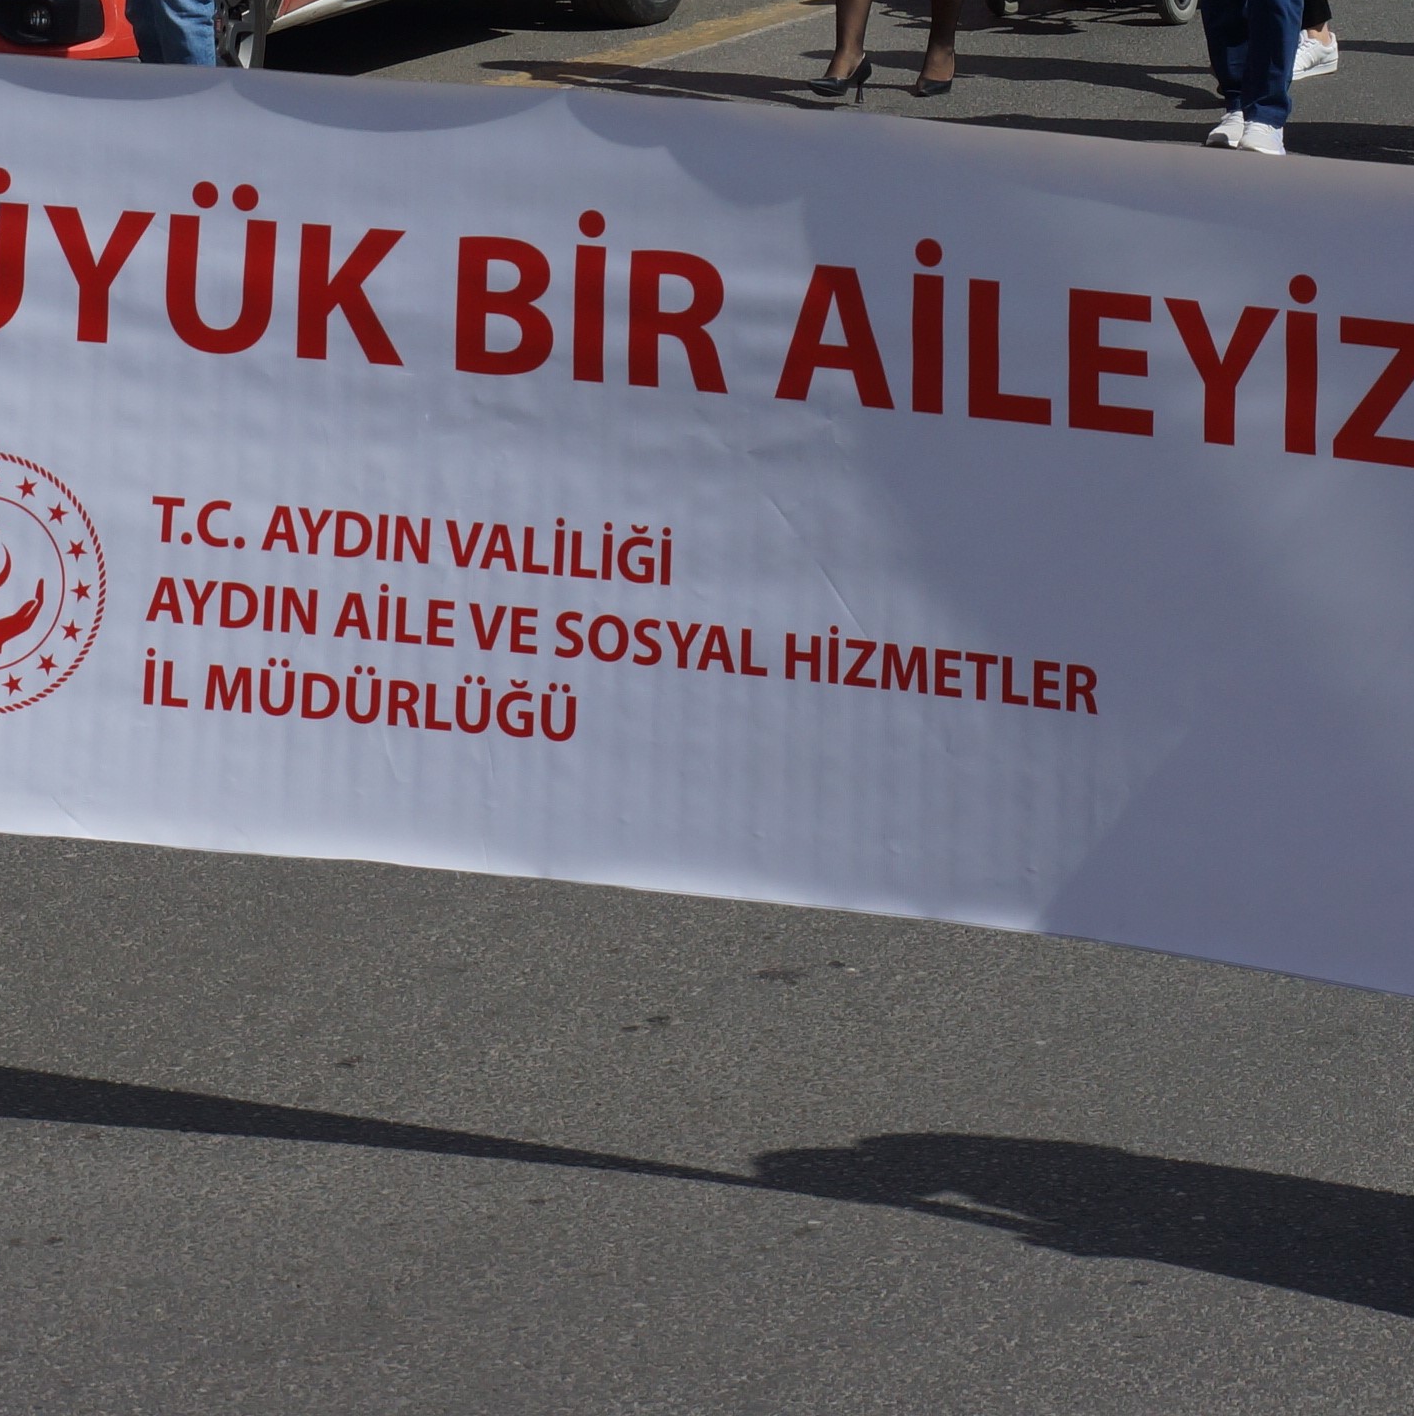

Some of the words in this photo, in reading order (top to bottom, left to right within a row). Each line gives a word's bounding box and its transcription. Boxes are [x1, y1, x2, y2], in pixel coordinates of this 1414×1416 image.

[454, 209, 728, 395] BİR
[152, 495, 246, 550] T.C.
[261, 506, 432, 565] AYDIN
[446, 517, 673, 586] VALİLİĞİ
[142, 647, 189, 709] İL
[204, 657, 577, 742] MÜDÜRLÜĞÜ
[145, 576, 318, 636] AYDIN
[333, 583, 456, 648] AİLE
[469, 602, 539, 655] VE
[554, 611, 769, 677] SOSYAL
[785, 624, 1099, 715] HİZMETLER
